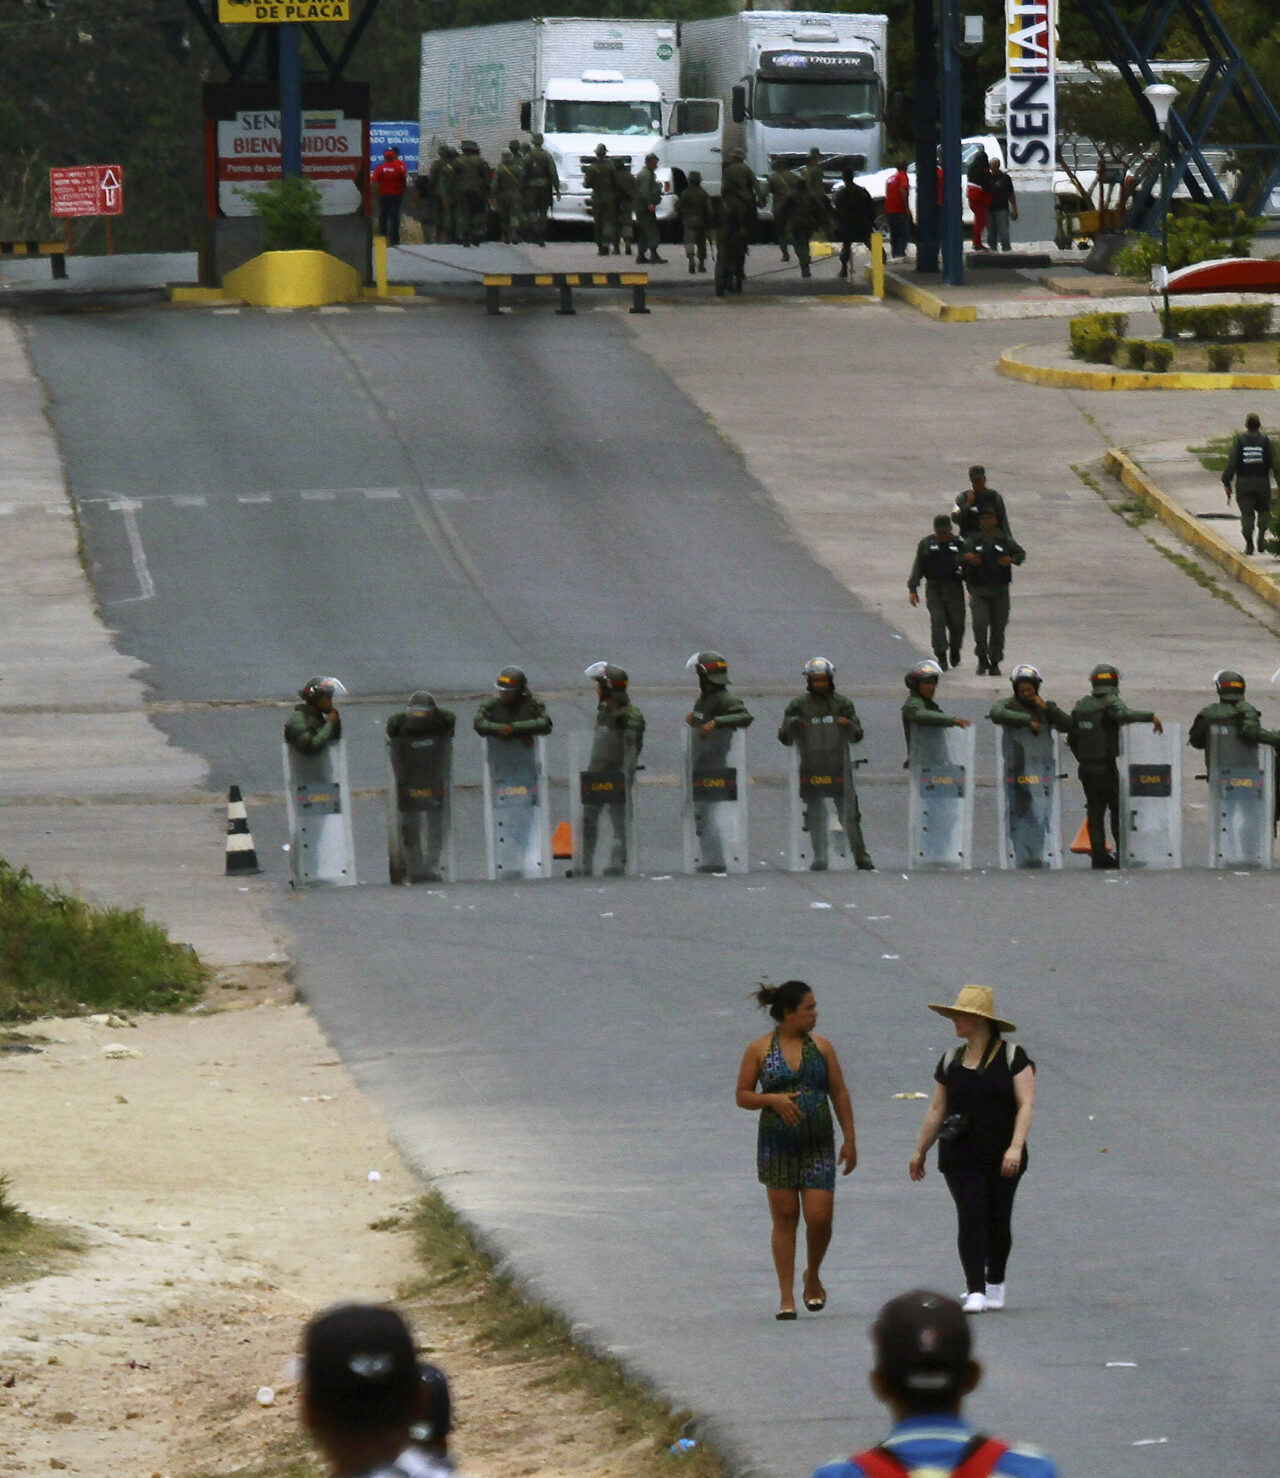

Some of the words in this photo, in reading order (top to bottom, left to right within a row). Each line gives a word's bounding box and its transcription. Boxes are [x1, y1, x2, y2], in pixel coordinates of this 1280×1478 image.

[256, 7, 279, 19] DE
[285, 5, 342, 18] PLACA
[1008, 0, 1050, 164] SENIAT
[810, 775, 832, 784] GNB
[1017, 775, 1039, 784] GNB
